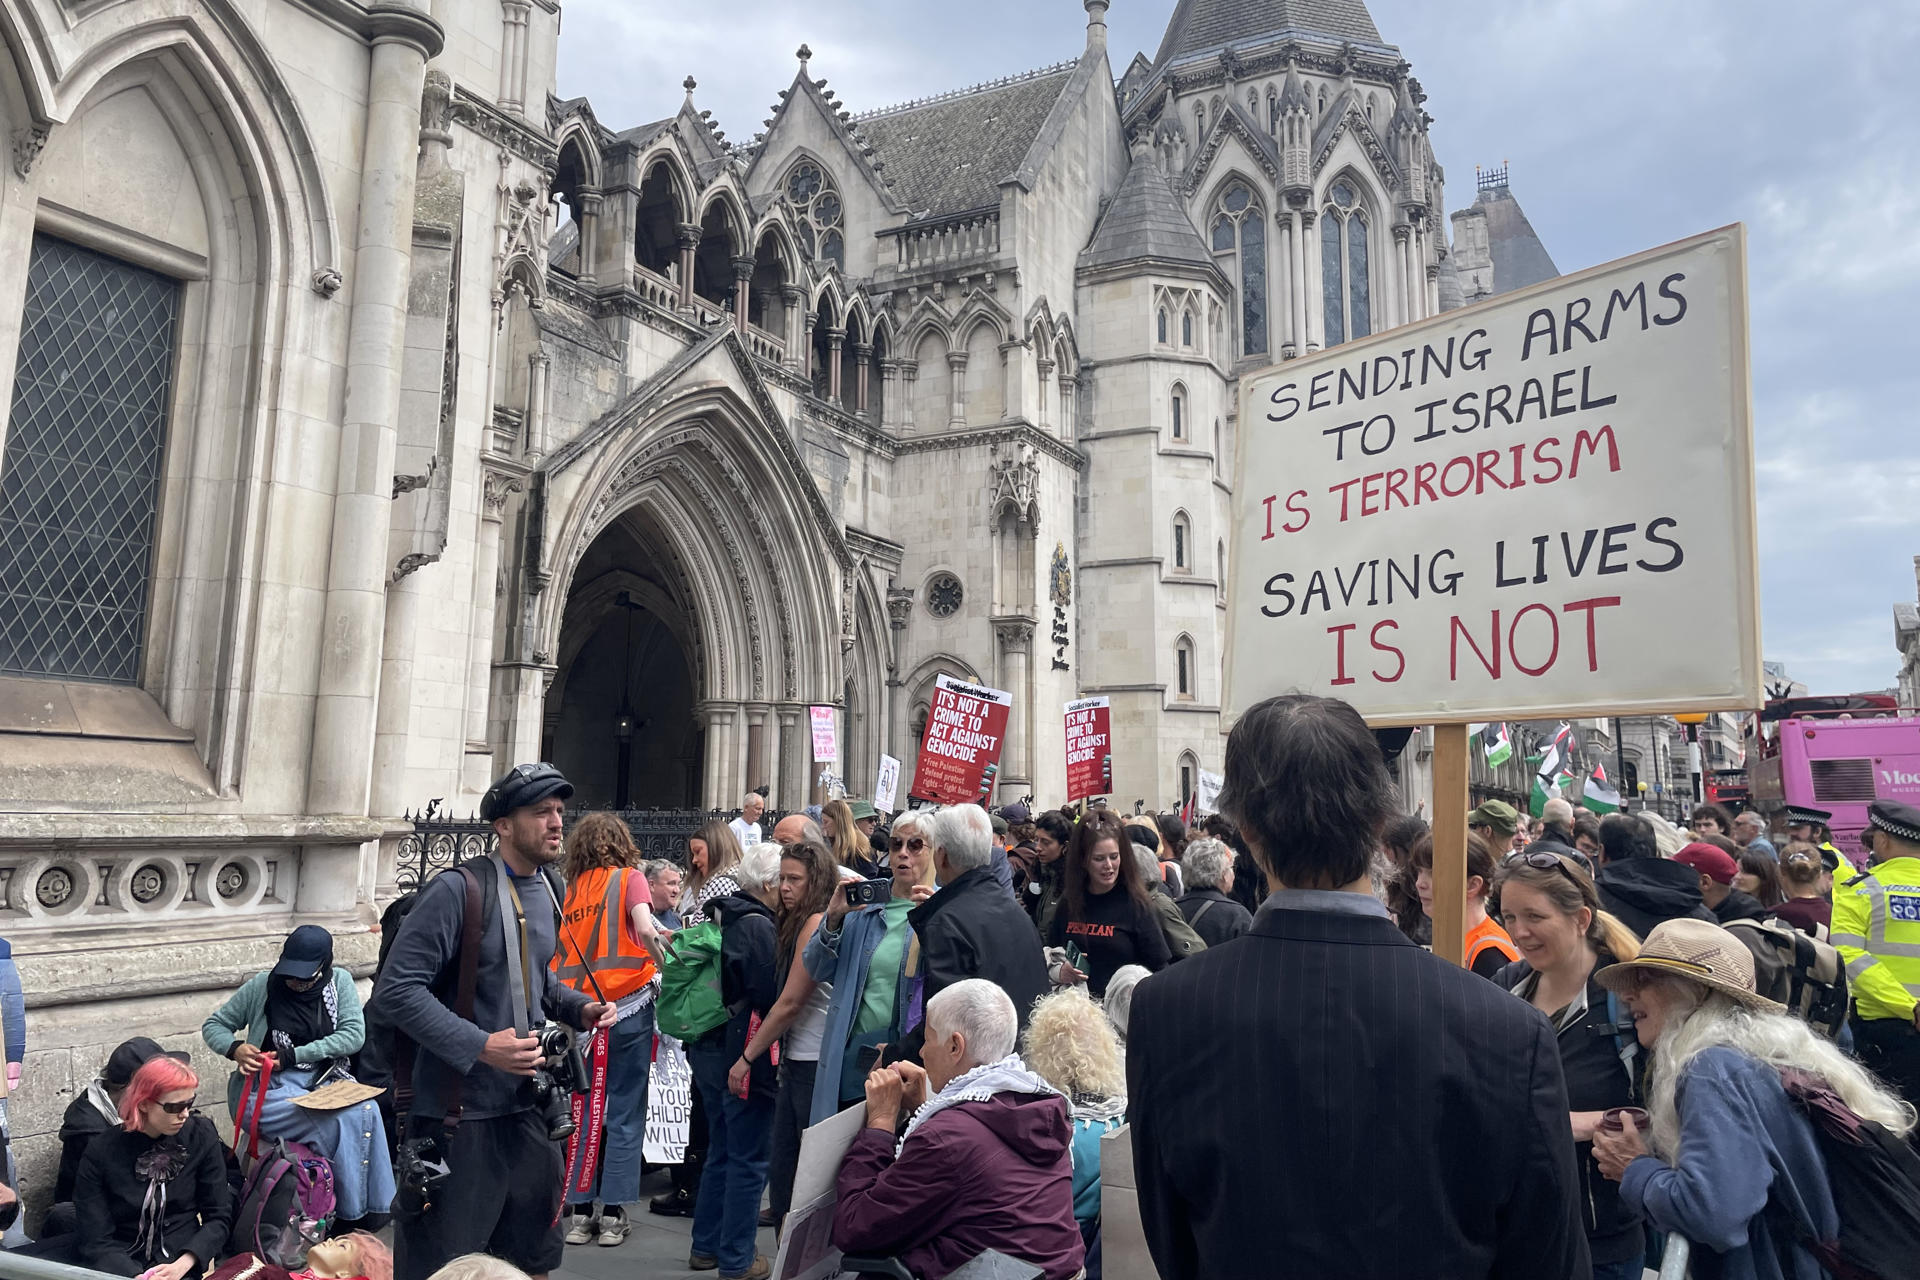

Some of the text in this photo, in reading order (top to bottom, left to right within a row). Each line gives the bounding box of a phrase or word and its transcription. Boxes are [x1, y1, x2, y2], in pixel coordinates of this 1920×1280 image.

[1266, 272, 1688, 422] SENDING ARMS
[1322, 365, 1618, 461] TO ISRAEL
[1261, 424, 1621, 541] IS TERRORISM
[1260, 516, 1684, 618] SAVING LIVES
[1327, 596, 1621, 686] IS NOT
[937, 690, 989, 717] IT'S NOT A
[1076, 710, 1089, 725] NOT
[1090, 709, 1096, 722] A
[934, 705, 983, 732] CRIME TO
[1066, 722, 1094, 740] CRIME TO
[926, 736, 978, 763] GENOCIDE
[929, 721, 998, 751] ACT AGAINST
[1077, 733, 1107, 750] AGAINST
[1067, 747, 1096, 765] GENOCIDE
[594, 1067, 604, 1087] FREE
[590, 1089, 602, 1144] PALESTINIAN
[645, 1127, 688, 1145] WILL
